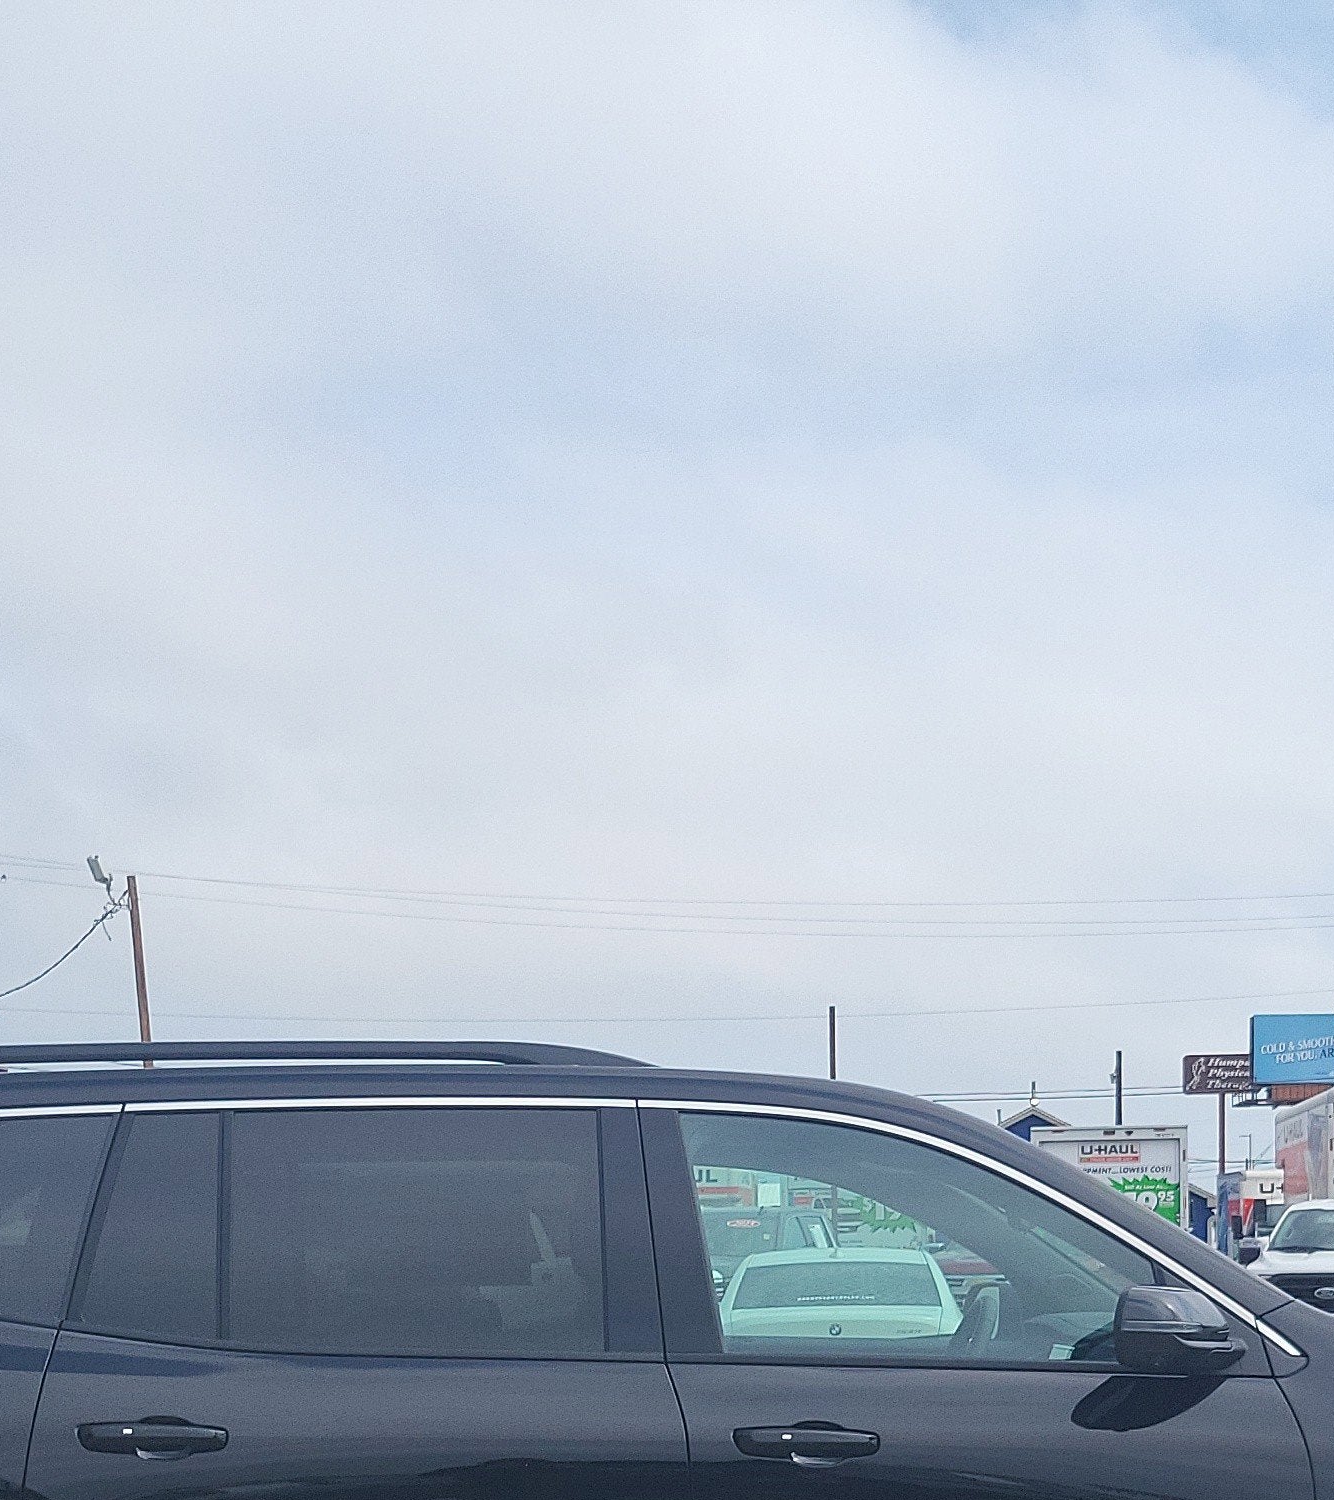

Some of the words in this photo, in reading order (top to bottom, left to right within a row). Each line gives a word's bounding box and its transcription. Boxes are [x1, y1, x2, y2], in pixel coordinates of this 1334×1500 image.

[1261, 1042, 1286, 1055] COLD
[1288, 1041, 1295, 1051] &
[1276, 1052, 1294, 1064] FOR
[1080, 1144, 1138, 1155] U-HAUL
